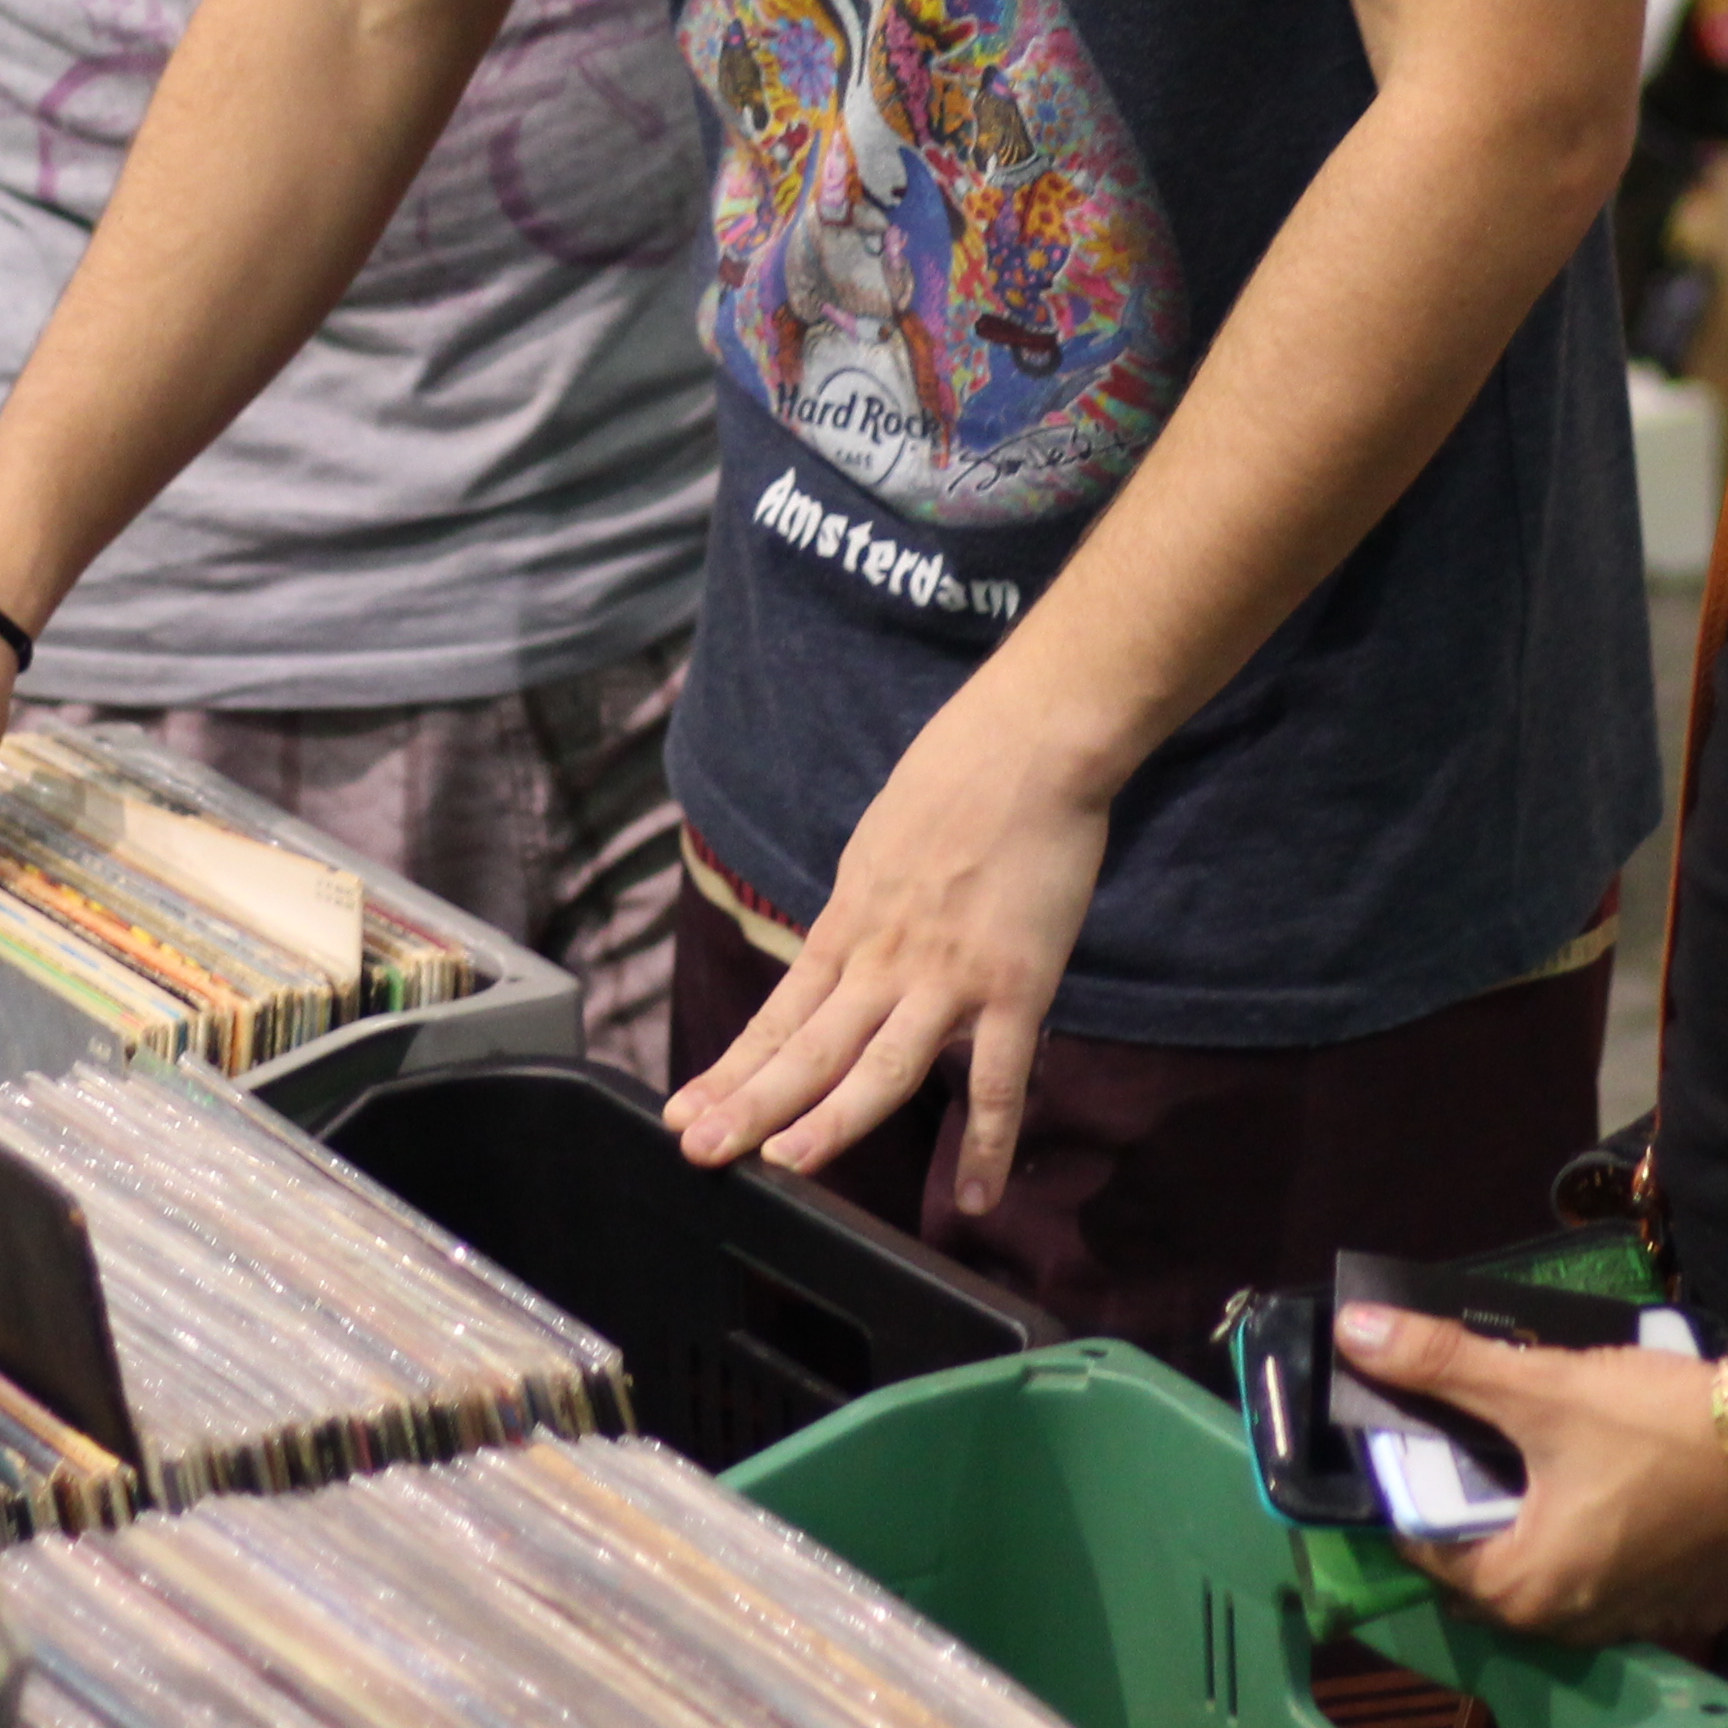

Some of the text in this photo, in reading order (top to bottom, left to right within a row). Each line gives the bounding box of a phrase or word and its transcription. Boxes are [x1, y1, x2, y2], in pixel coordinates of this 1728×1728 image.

[777, 381, 941, 448] Hard Rock
[754, 467, 1021, 621] Amsterdam
